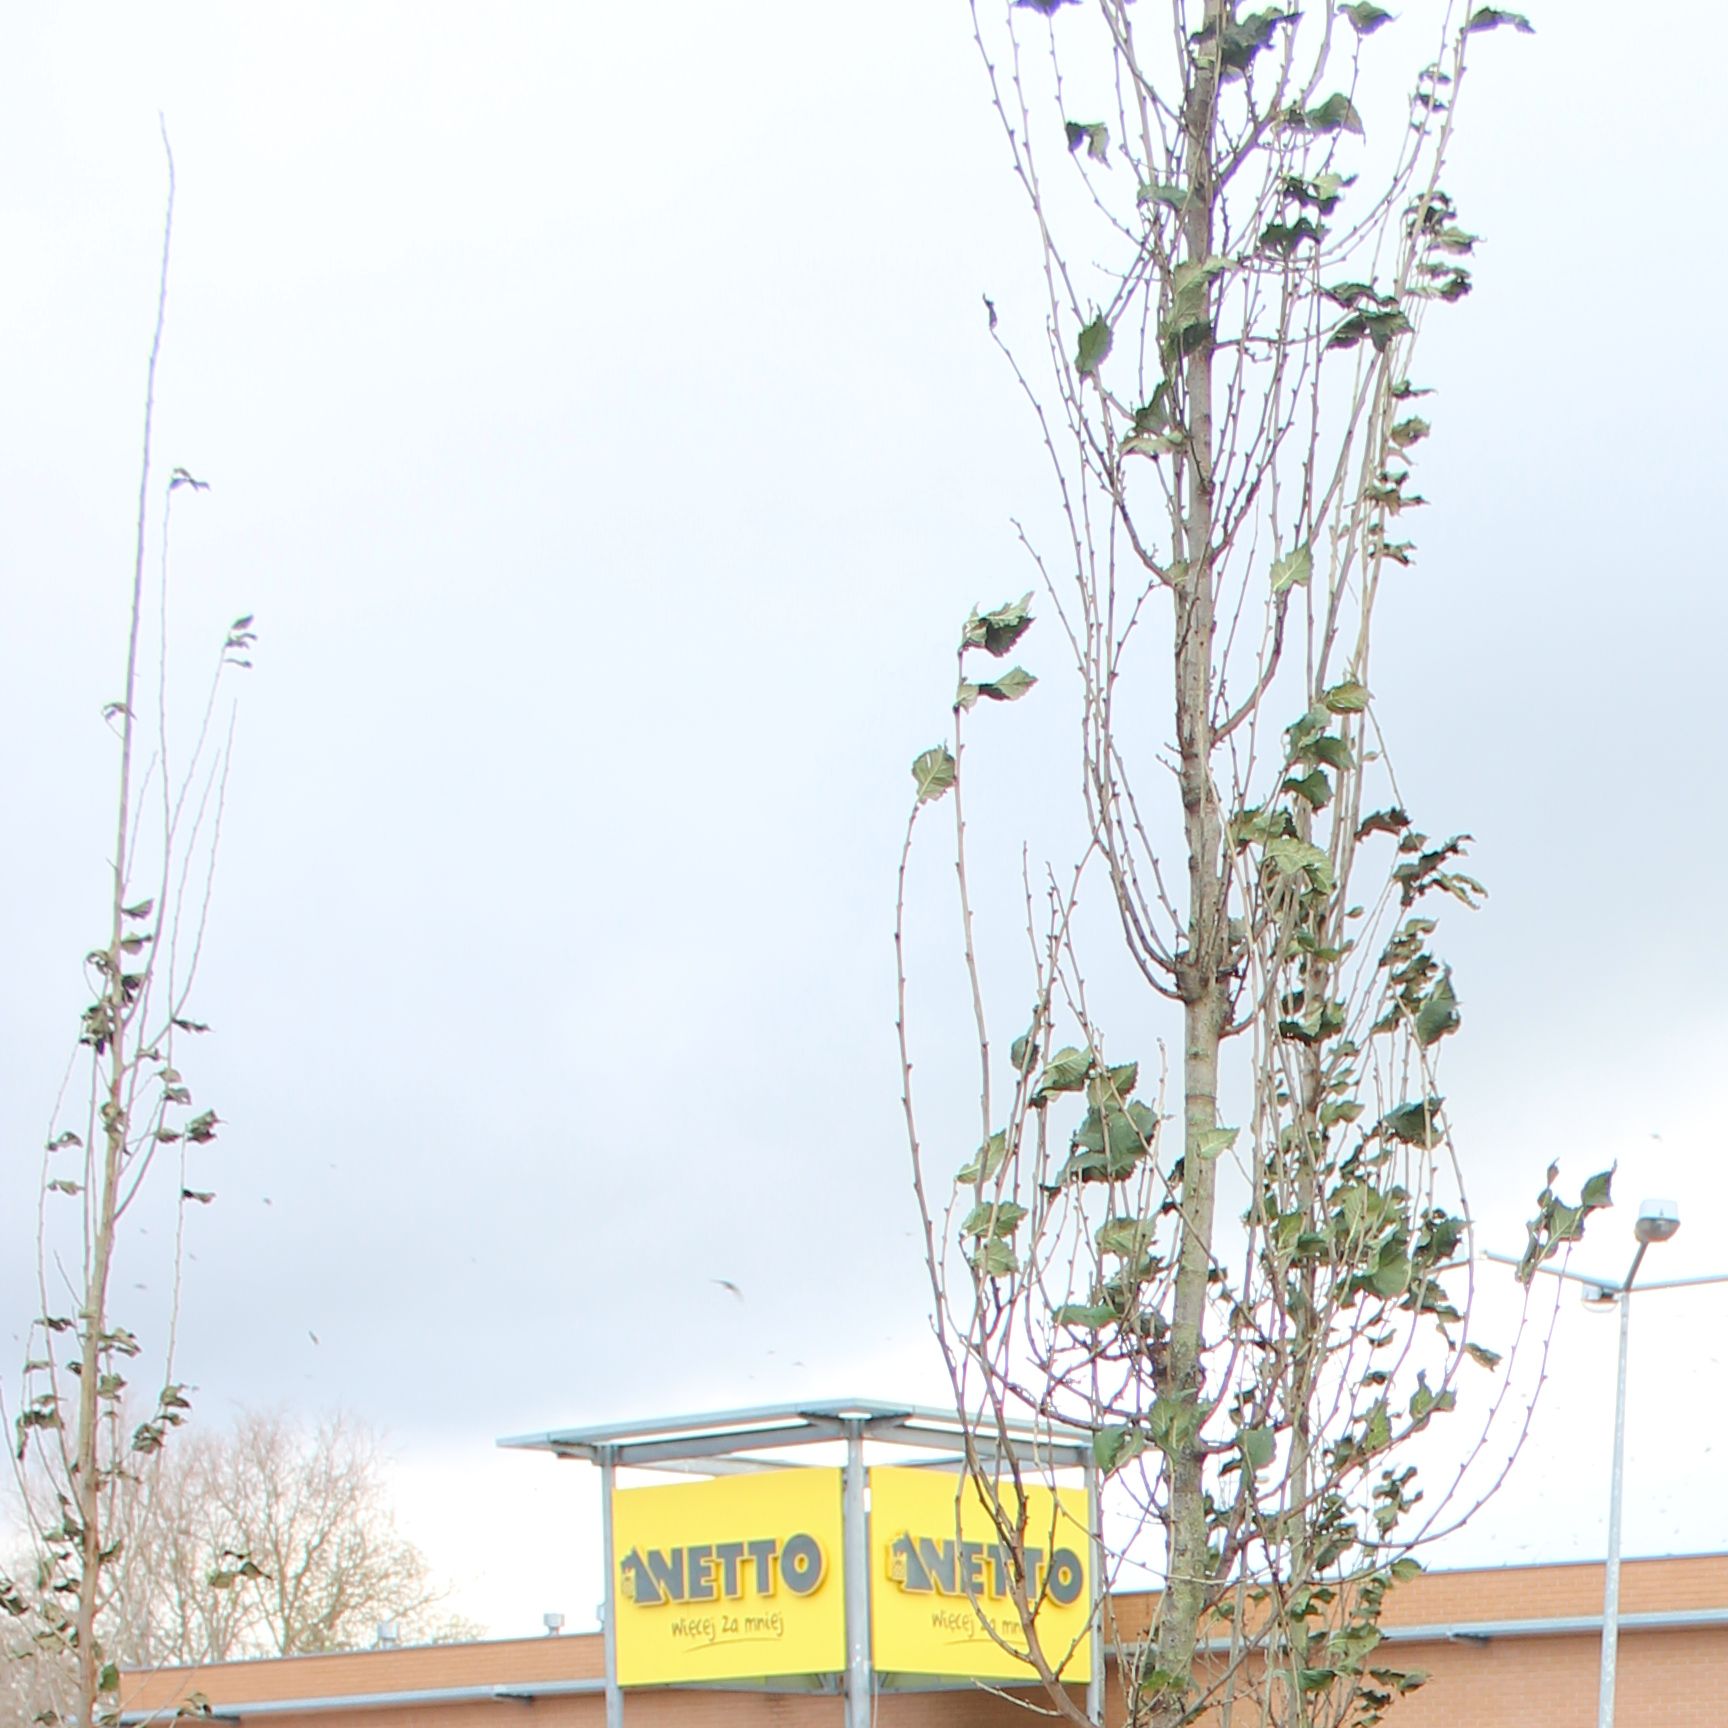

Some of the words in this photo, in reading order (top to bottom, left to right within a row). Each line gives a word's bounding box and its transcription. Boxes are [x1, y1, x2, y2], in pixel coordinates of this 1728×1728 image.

[621, 1533, 823, 1604] NETTO
[891, 1531, 1084, 1604] NETTO
[671, 1614, 716, 1642] więcej
[722, 1615, 739, 1633] za
[745, 1613, 784, 1636] mniej
[932, 1610, 975, 1637] więcej
